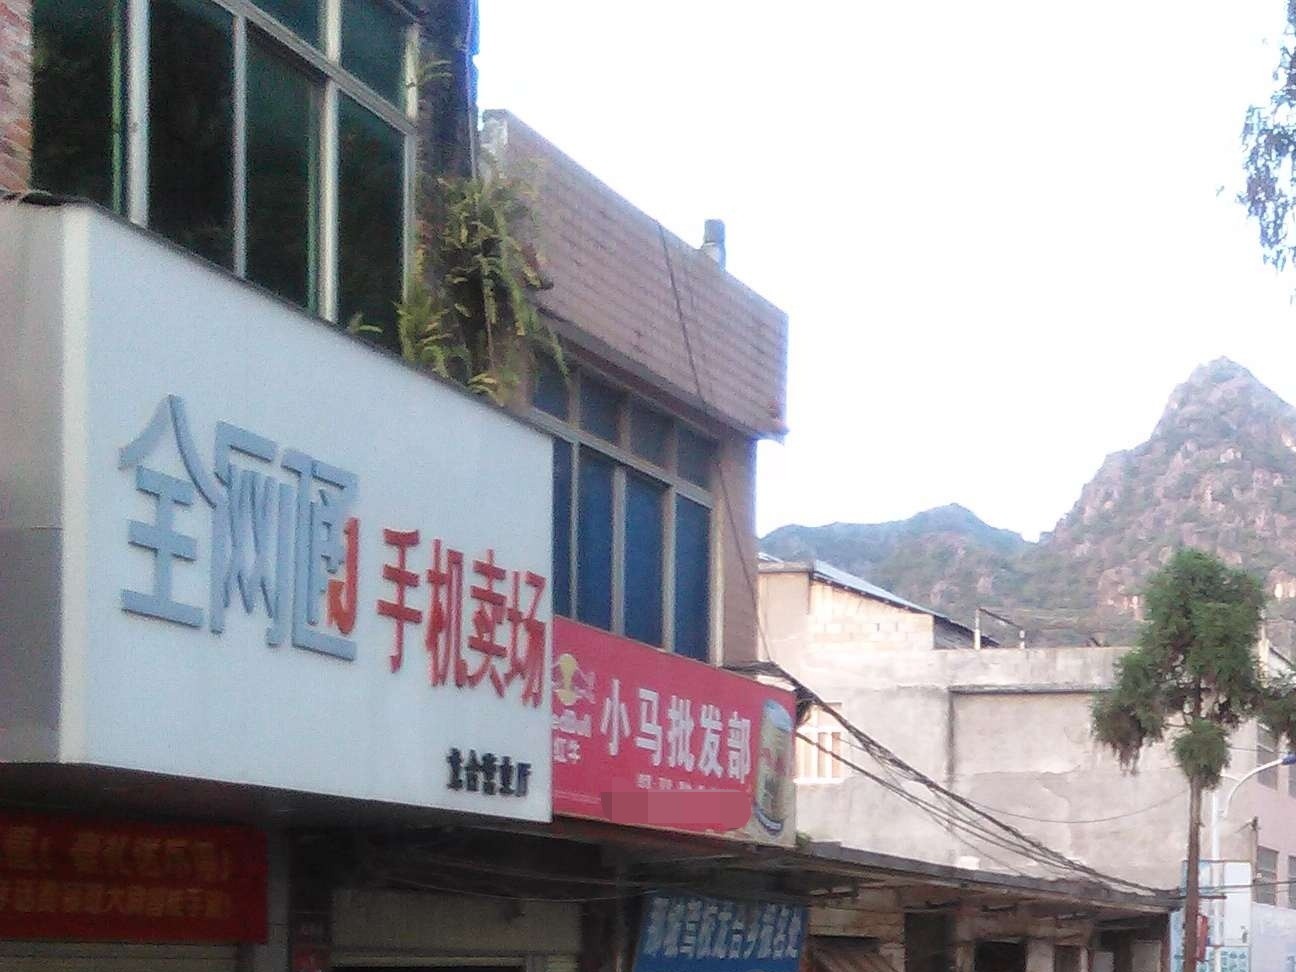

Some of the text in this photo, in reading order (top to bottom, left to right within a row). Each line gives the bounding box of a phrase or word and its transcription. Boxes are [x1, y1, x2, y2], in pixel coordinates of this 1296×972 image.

[118, 393, 547, 709] 全网通 手机卖场
[600, 677, 752, 785] 小马批发部
